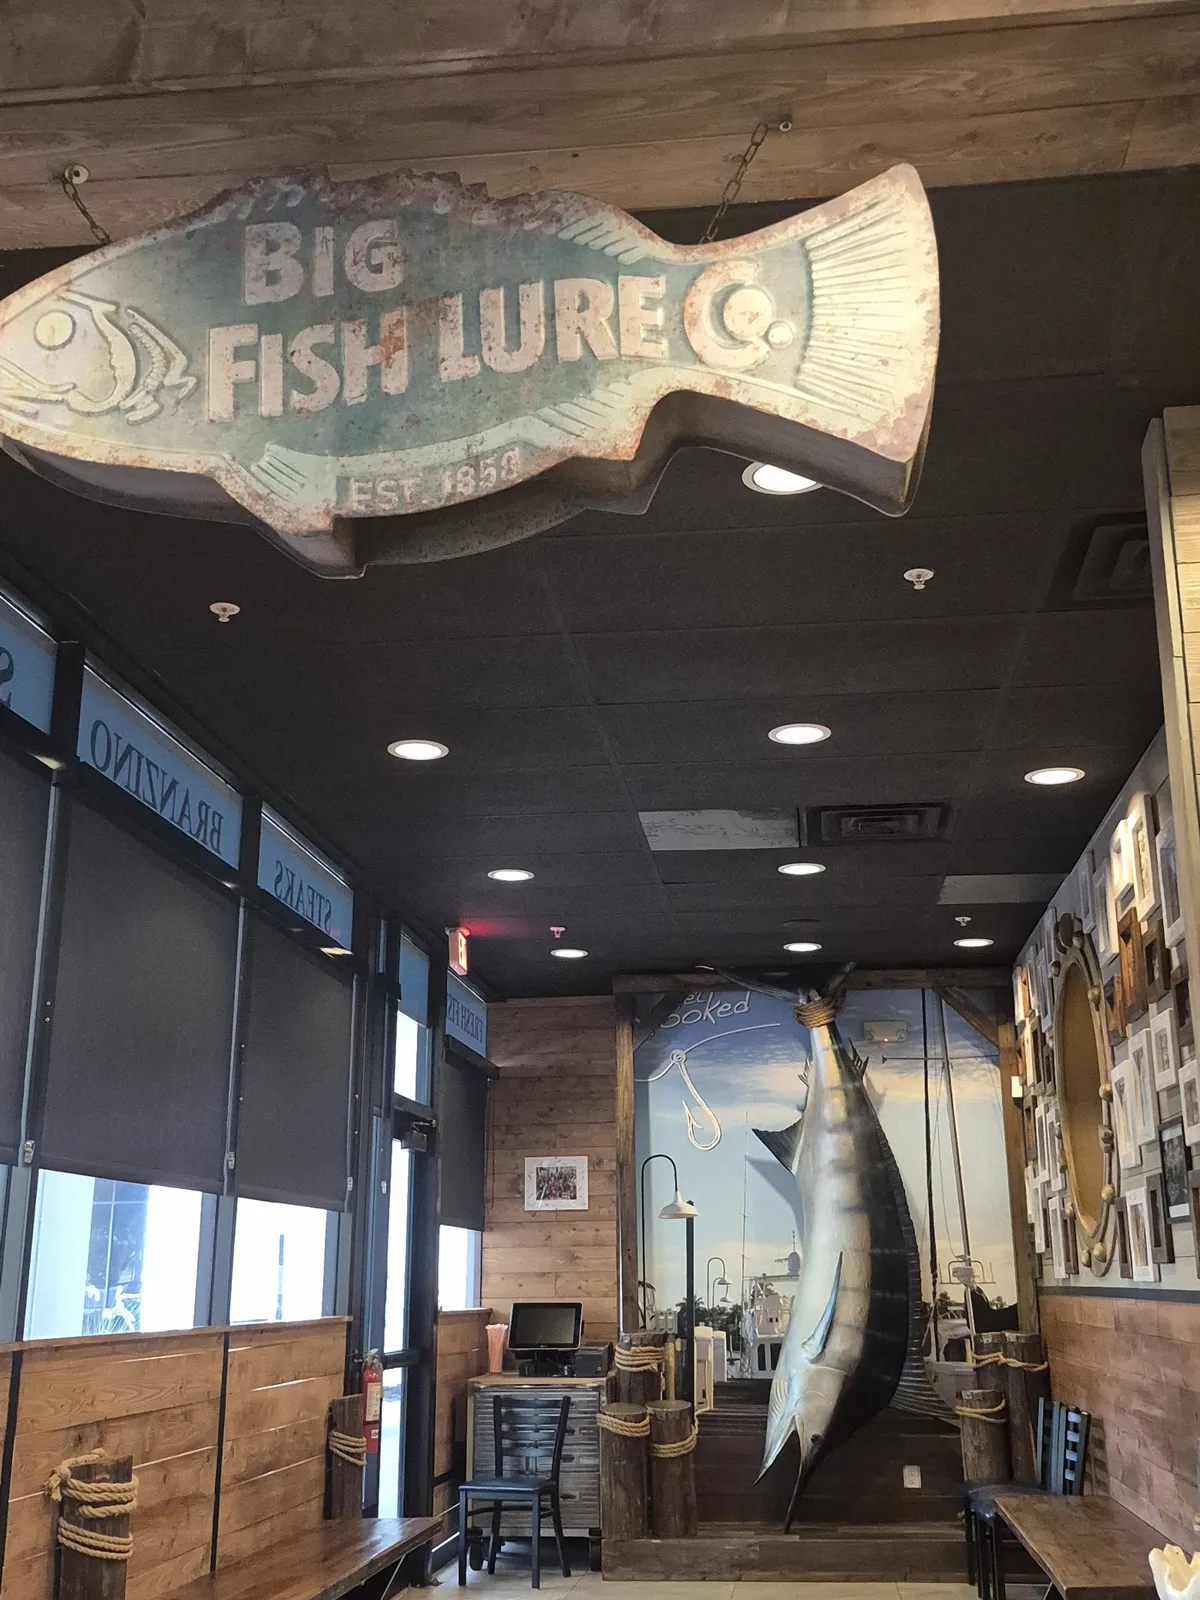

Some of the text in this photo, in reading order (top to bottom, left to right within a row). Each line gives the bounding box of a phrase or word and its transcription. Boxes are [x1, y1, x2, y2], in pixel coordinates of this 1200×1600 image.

[243, 219, 404, 306] BIG
[207, 304, 409, 423] FISH
[438, 274, 669, 383] LURE
[660, 991, 751, 1029] ooked
